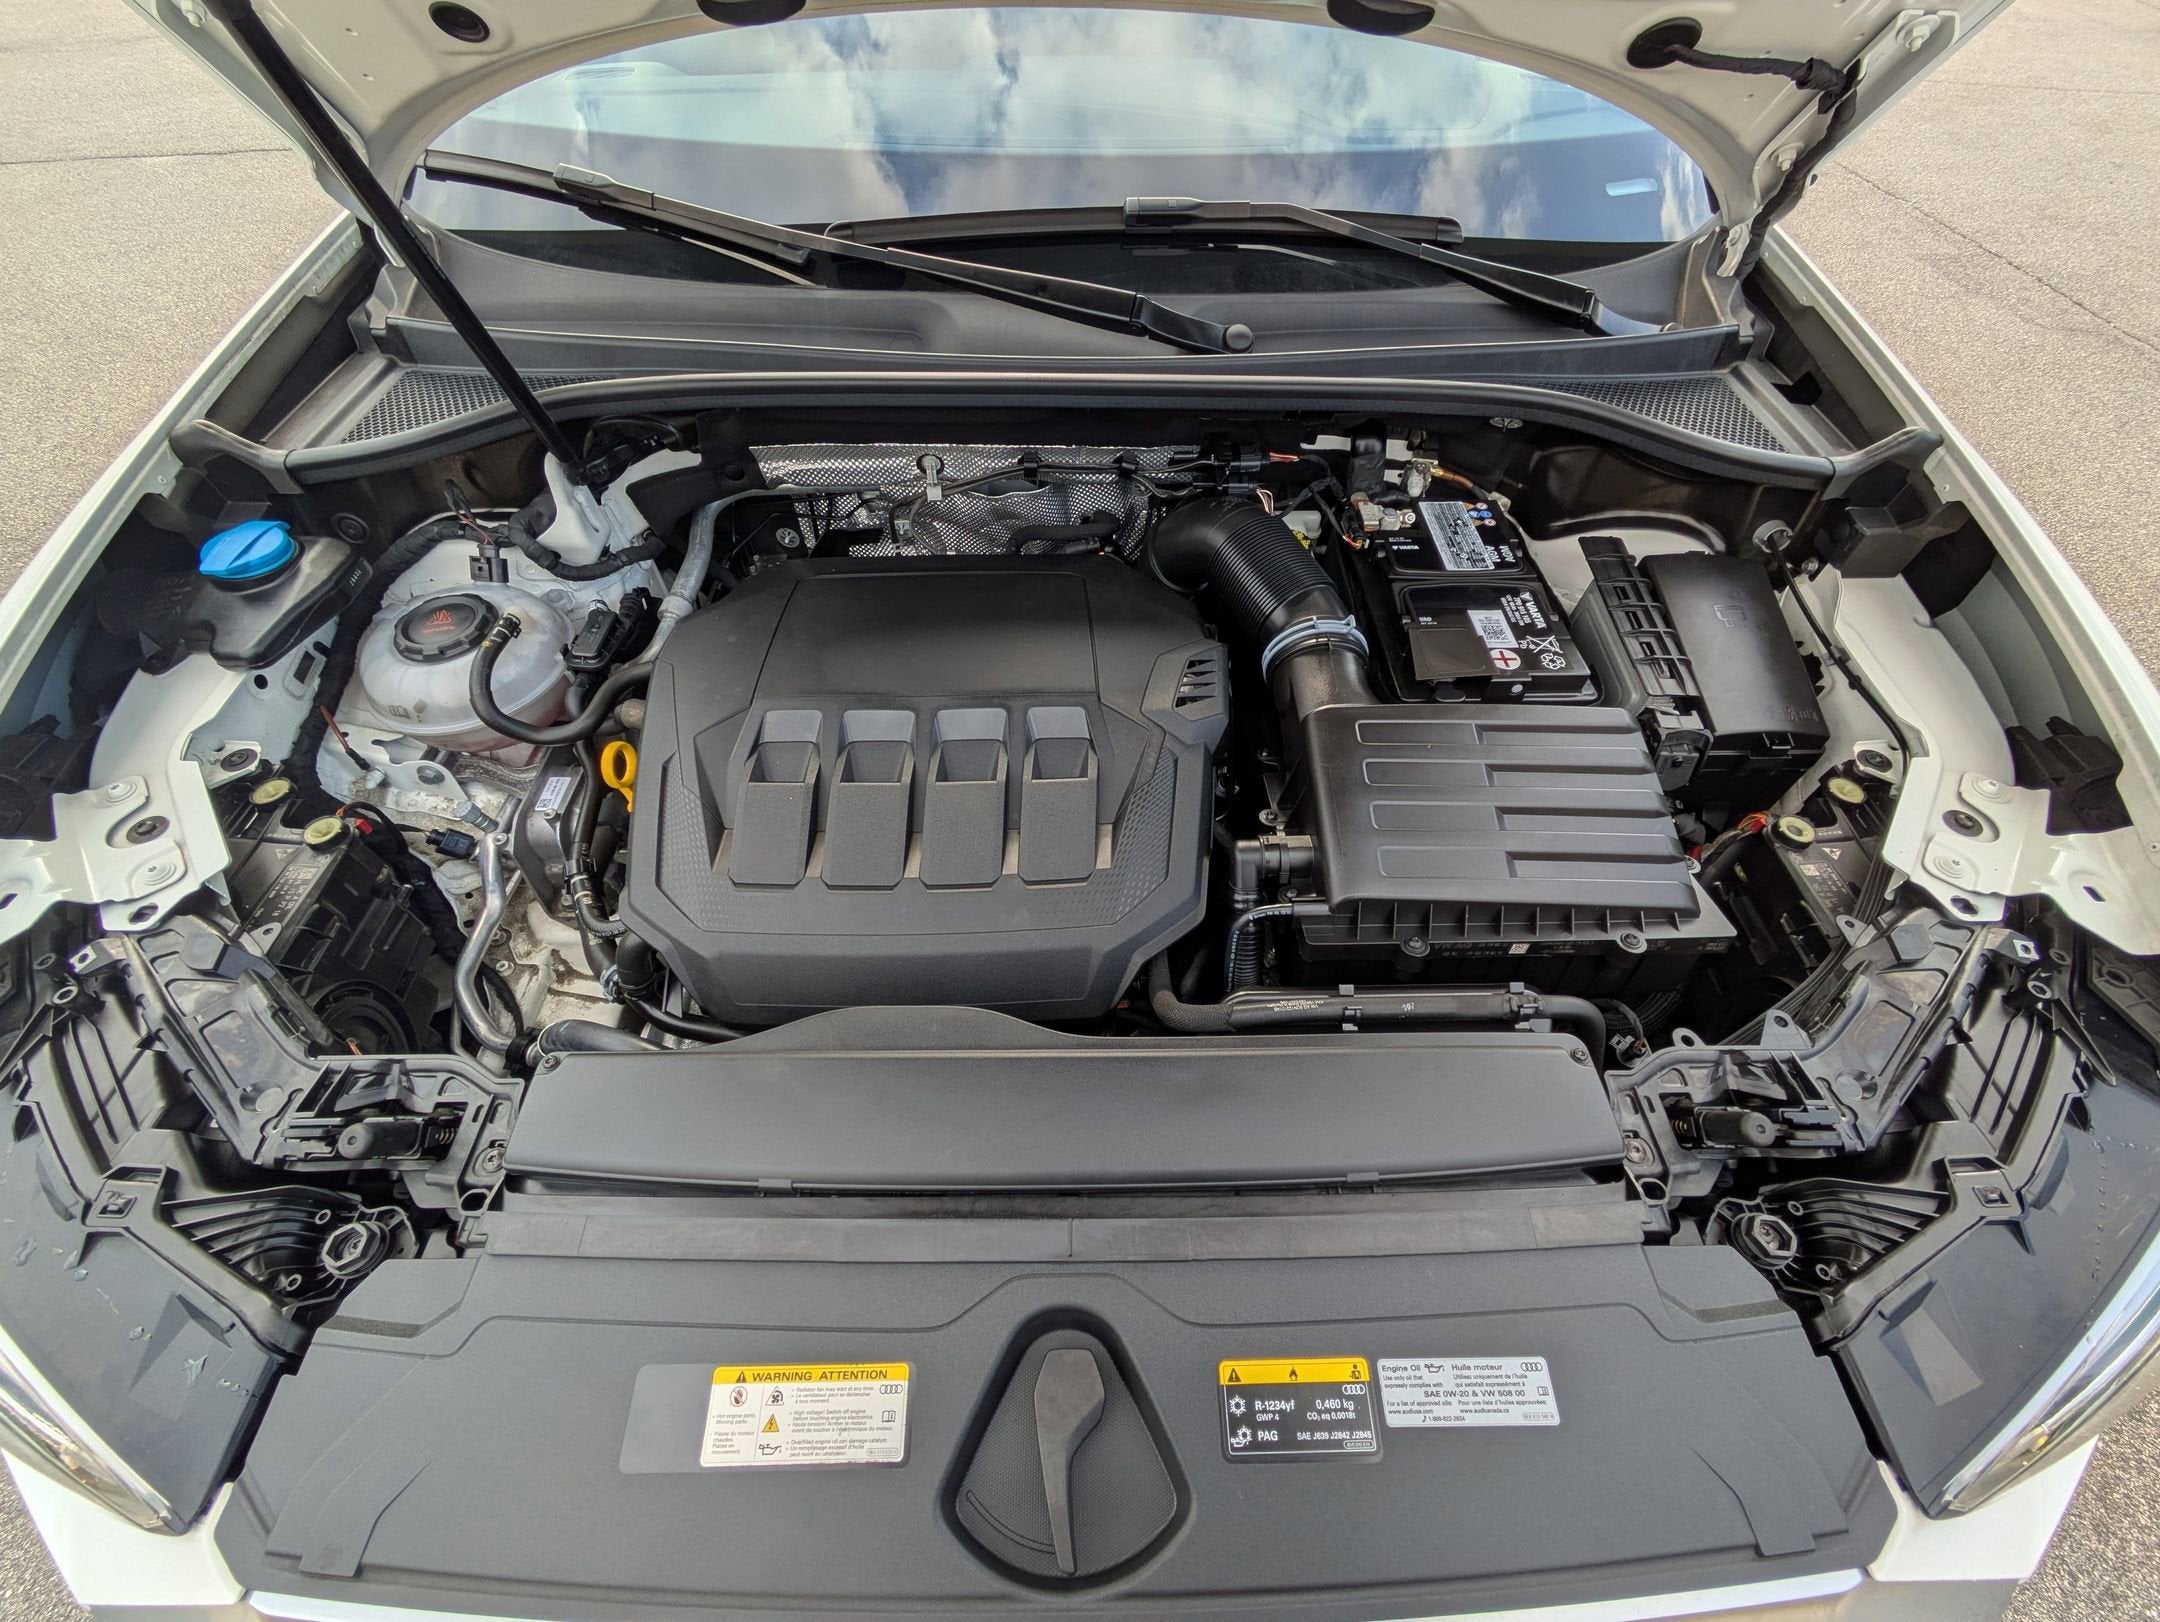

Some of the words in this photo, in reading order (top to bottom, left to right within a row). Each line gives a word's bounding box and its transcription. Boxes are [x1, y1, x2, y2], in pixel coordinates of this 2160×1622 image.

[1485, 546, 1501, 562] AGM
[1526, 601, 1547, 628] VARTA
[1382, 1365, 1408, 1373] Engine
[752, 1371, 812, 1382] WARNING
[819, 1370, 888, 1380] ATTENTION
[1255, 1400, 1295, 1412] R-1234yf
[1316, 1400, 1341, 1410] 0,460
[1343, 1400, 1354, 1410] kg
[1256, 1413, 1274, 1421] GWP
[1322, 1413, 1330, 1421] eq
[1258, 1431, 1278, 1441] PAG
[1297, 1432, 1311, 1440] SAE
[1313, 1432, 1328, 1440] J639
[1331, 1431, 1350, 1440] J2842
[1352, 1430, 1372, 1439] J2845
